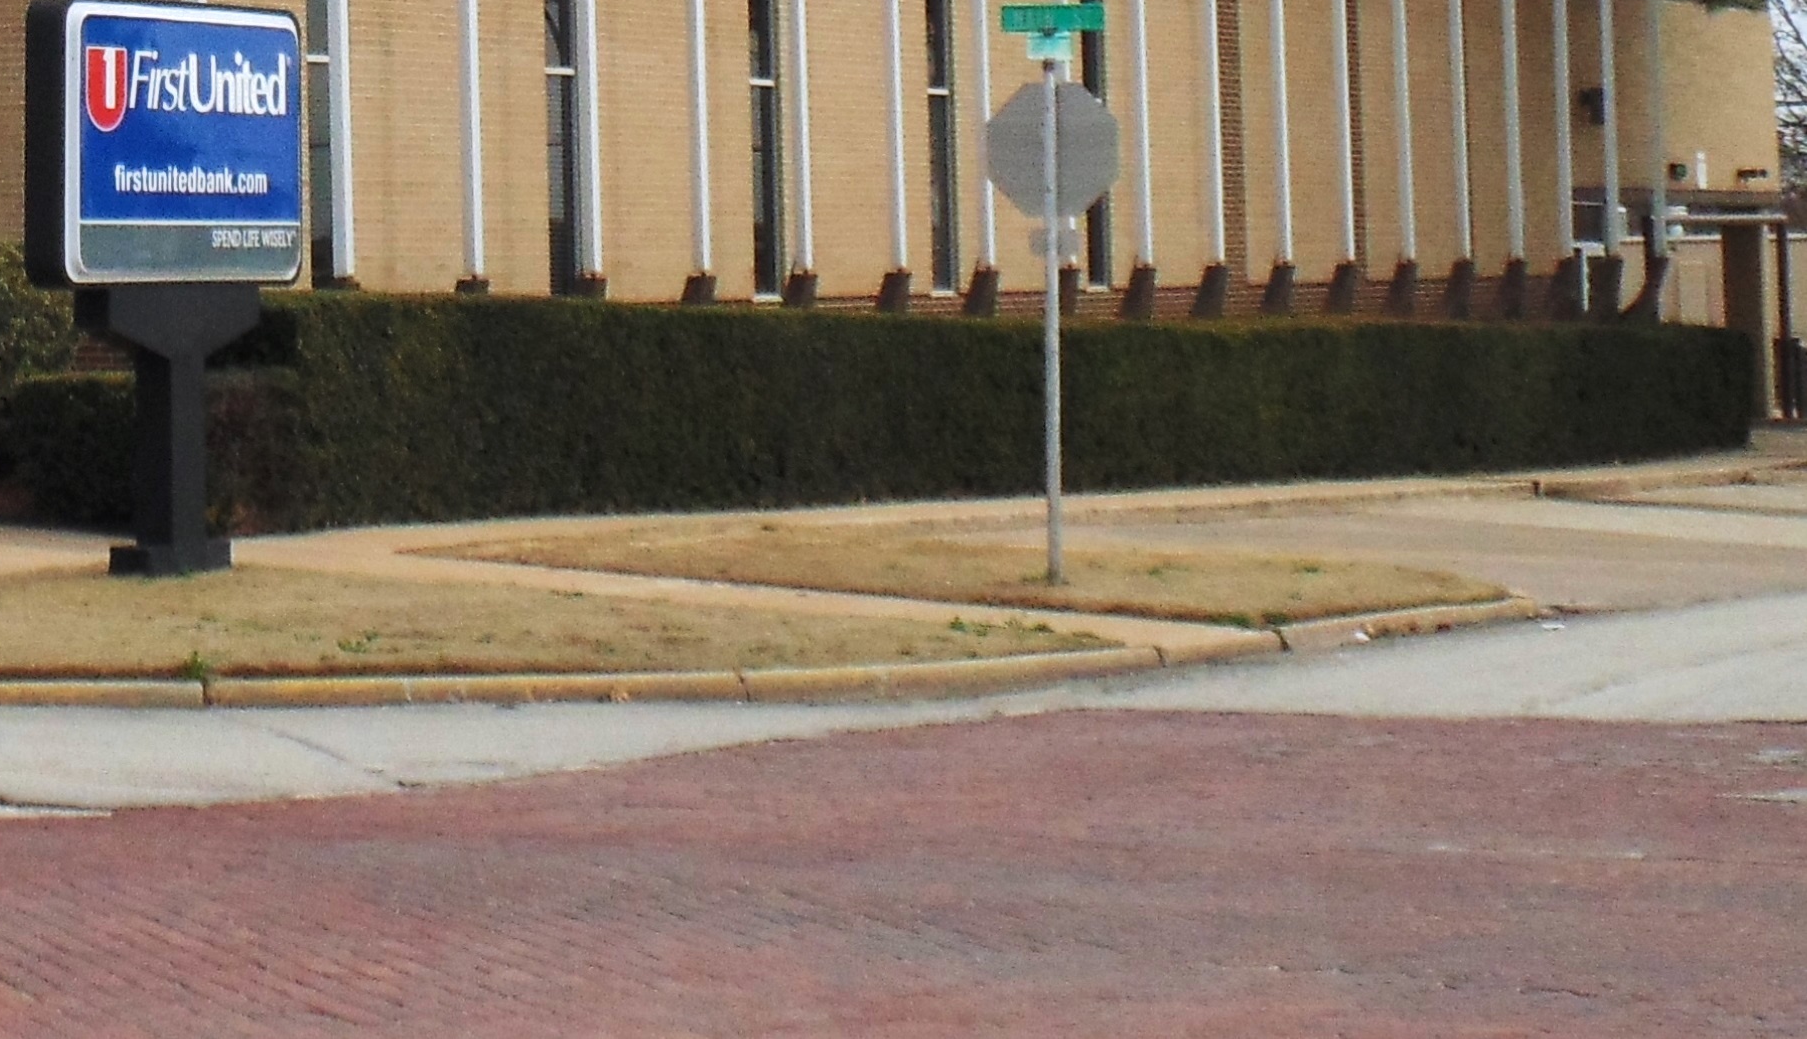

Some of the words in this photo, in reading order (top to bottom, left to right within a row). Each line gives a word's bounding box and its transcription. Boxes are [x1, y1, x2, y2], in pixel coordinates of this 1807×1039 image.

[114, 164, 268, 194] firstunitedbank.com
[211, 229, 242, 248] SPEND
[242, 229, 260, 248] LIFE
[261, 230, 293, 248] WISELY
